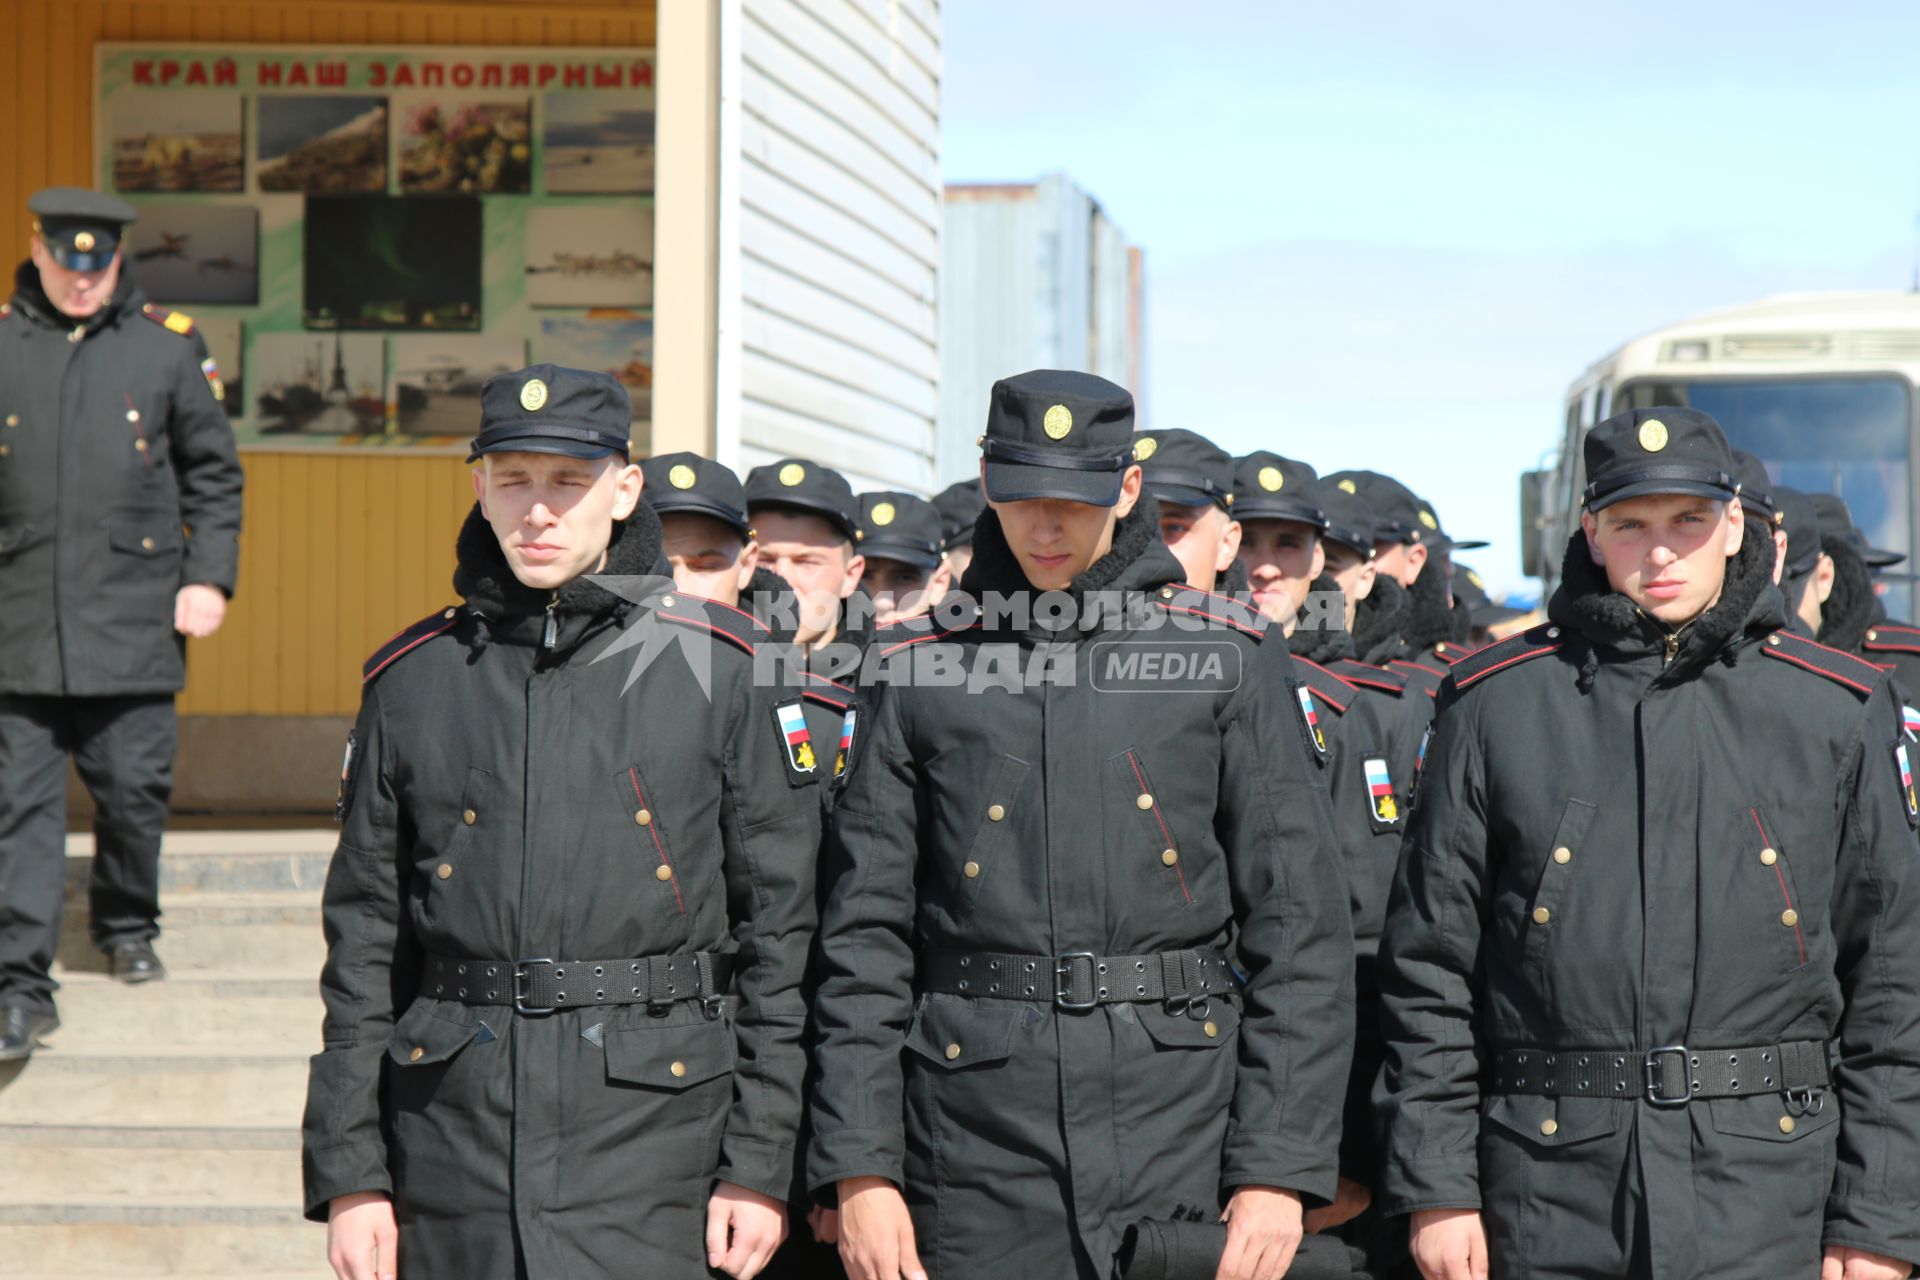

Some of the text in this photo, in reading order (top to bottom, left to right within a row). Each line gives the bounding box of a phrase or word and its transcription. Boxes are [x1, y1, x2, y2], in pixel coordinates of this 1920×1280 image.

[132, 56, 653, 90] КРАЙ НАШ ЗАПОЛЯРНЫЙ
